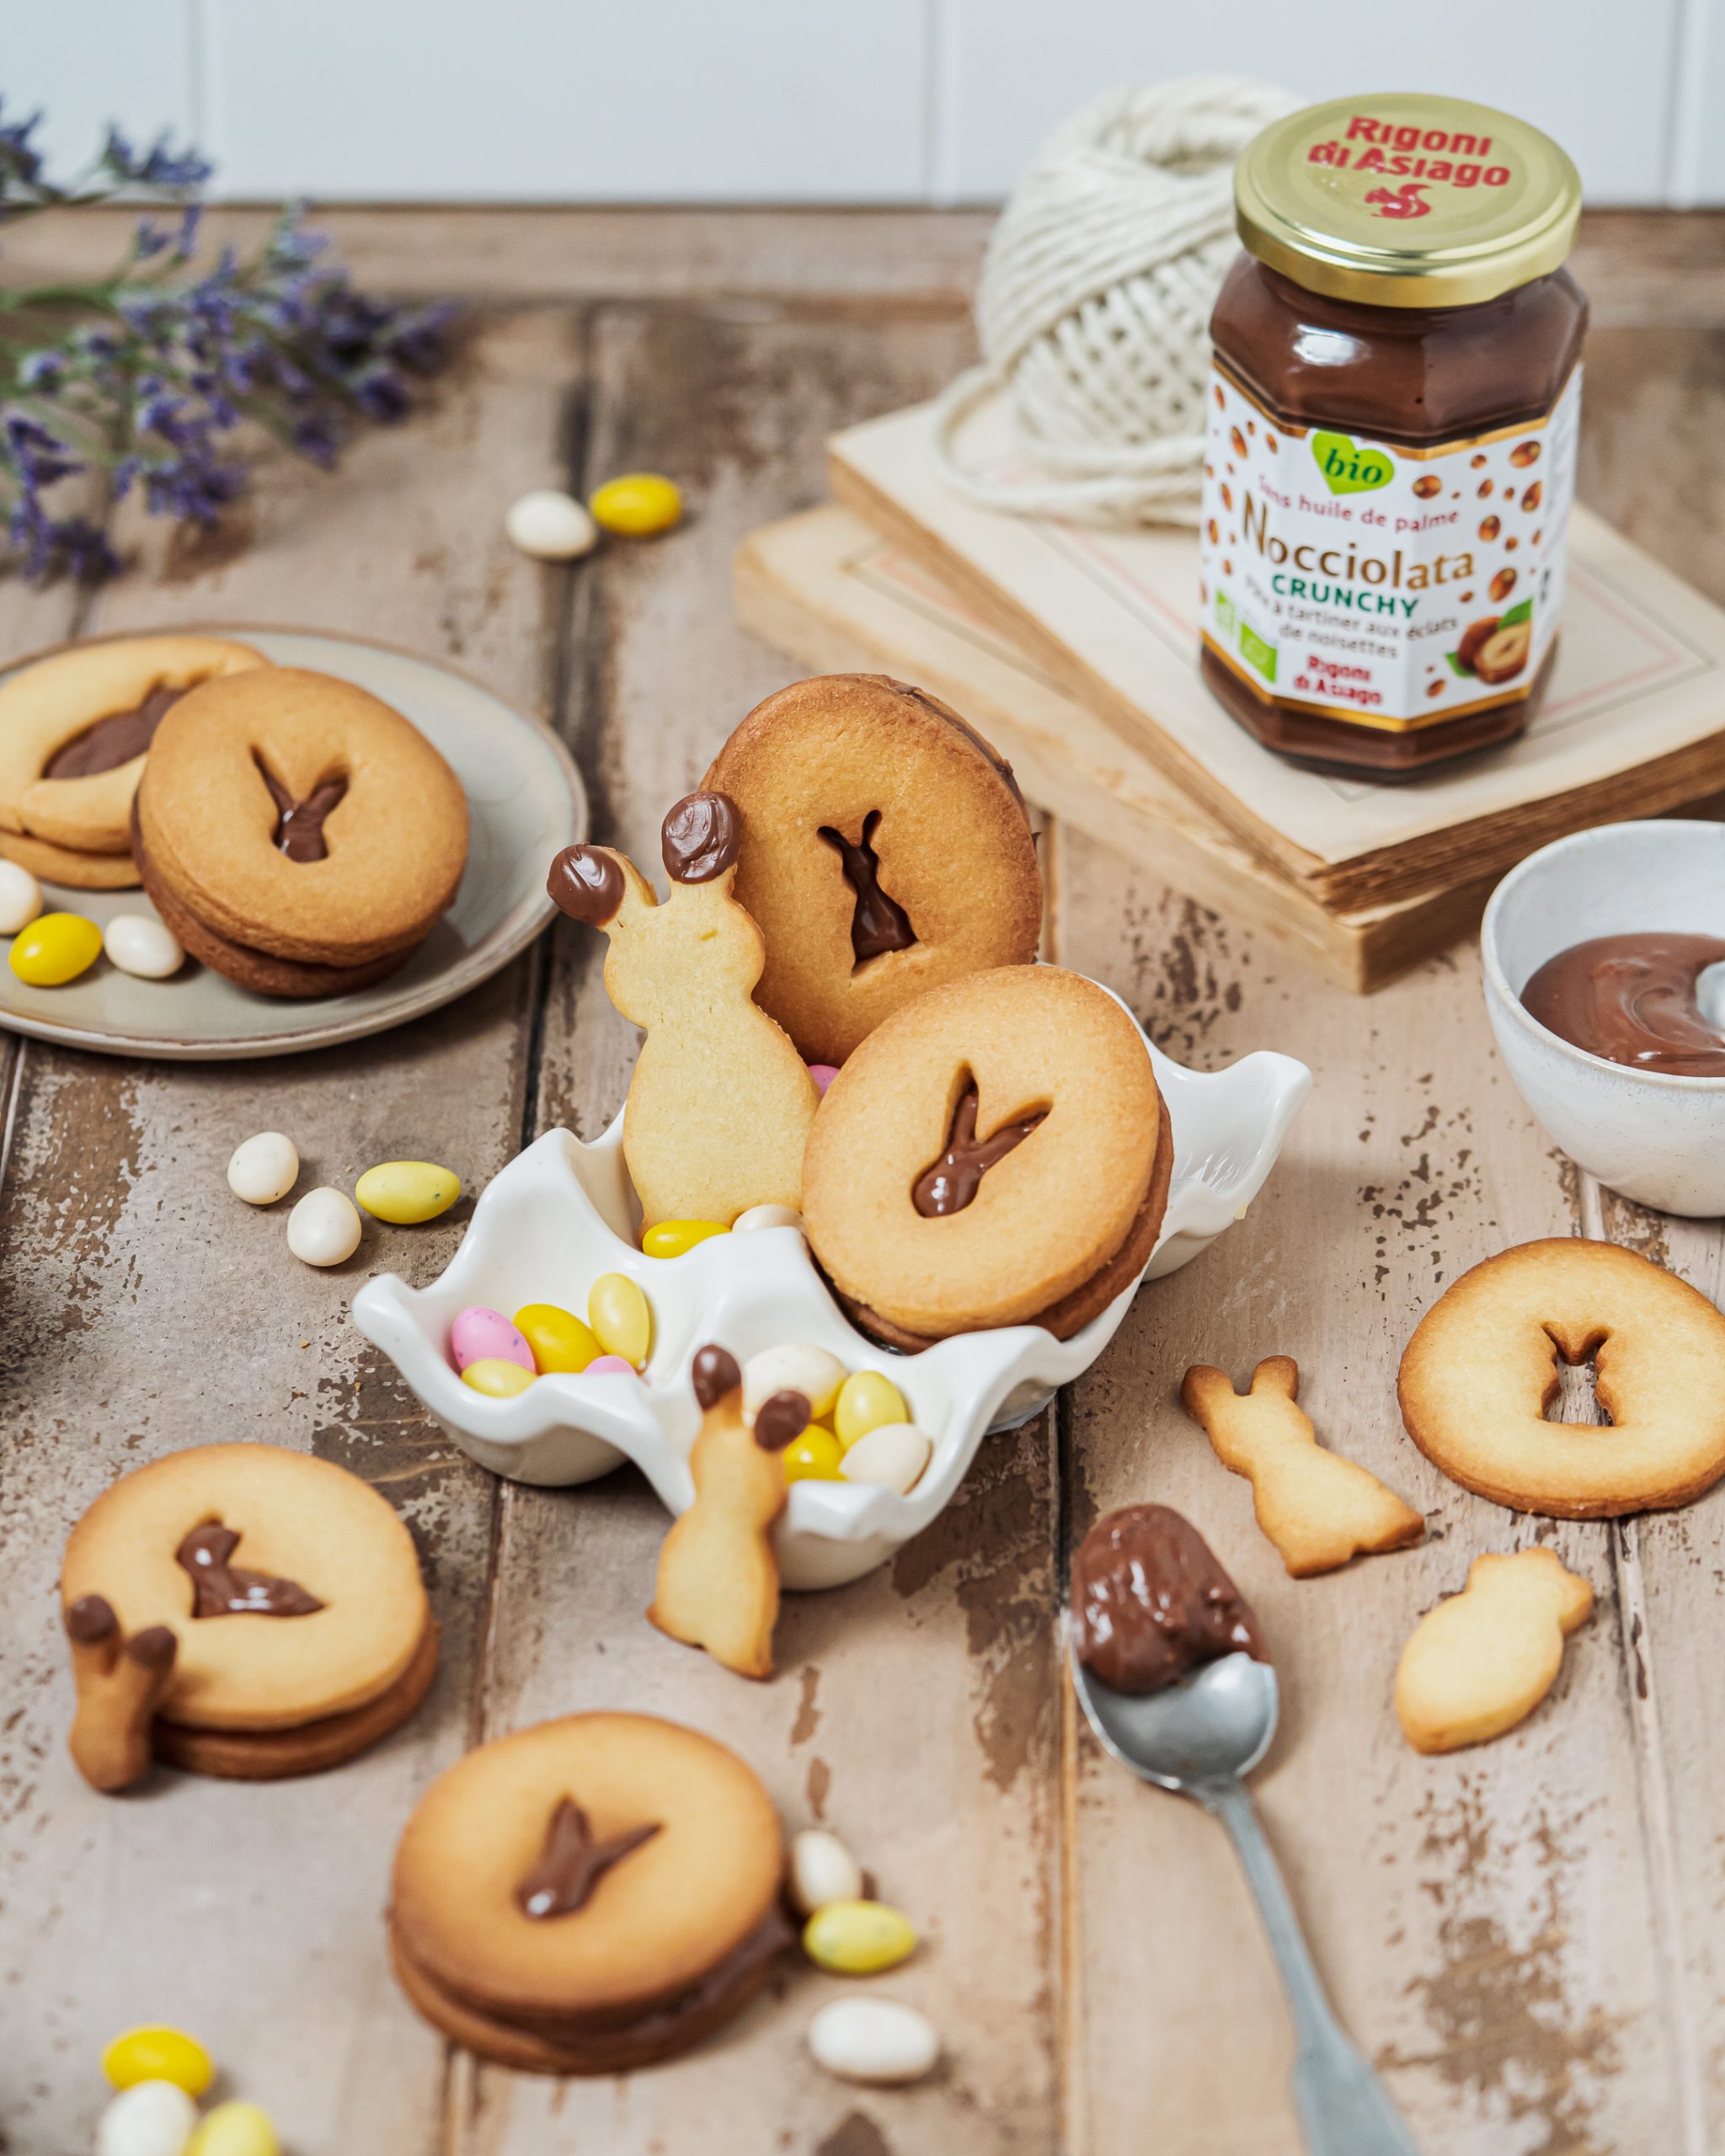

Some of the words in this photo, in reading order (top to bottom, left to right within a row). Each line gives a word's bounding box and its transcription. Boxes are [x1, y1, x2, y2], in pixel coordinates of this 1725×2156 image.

[1345, 115, 1493, 158] Rigoni
[1307, 139, 1351, 168] di
[1352, 147, 1511, 189] Asiago
[1324, 447, 1384, 486] bio
[1298, 493, 1354, 521] huile
[1360, 507, 1387, 527] de
[1395, 509, 1460, 534] palme
[1242, 489, 1475, 591] Nocciolata
[1271, 574, 1419, 619] CRUNCHY
[1279, 623, 1301, 639] de
[1307, 632, 1398, 660] noisettes
[1288, 604, 1360, 632] tartiner
[1367, 622, 1400, 638] aux
[1307, 654, 1372, 682] Rigoni
